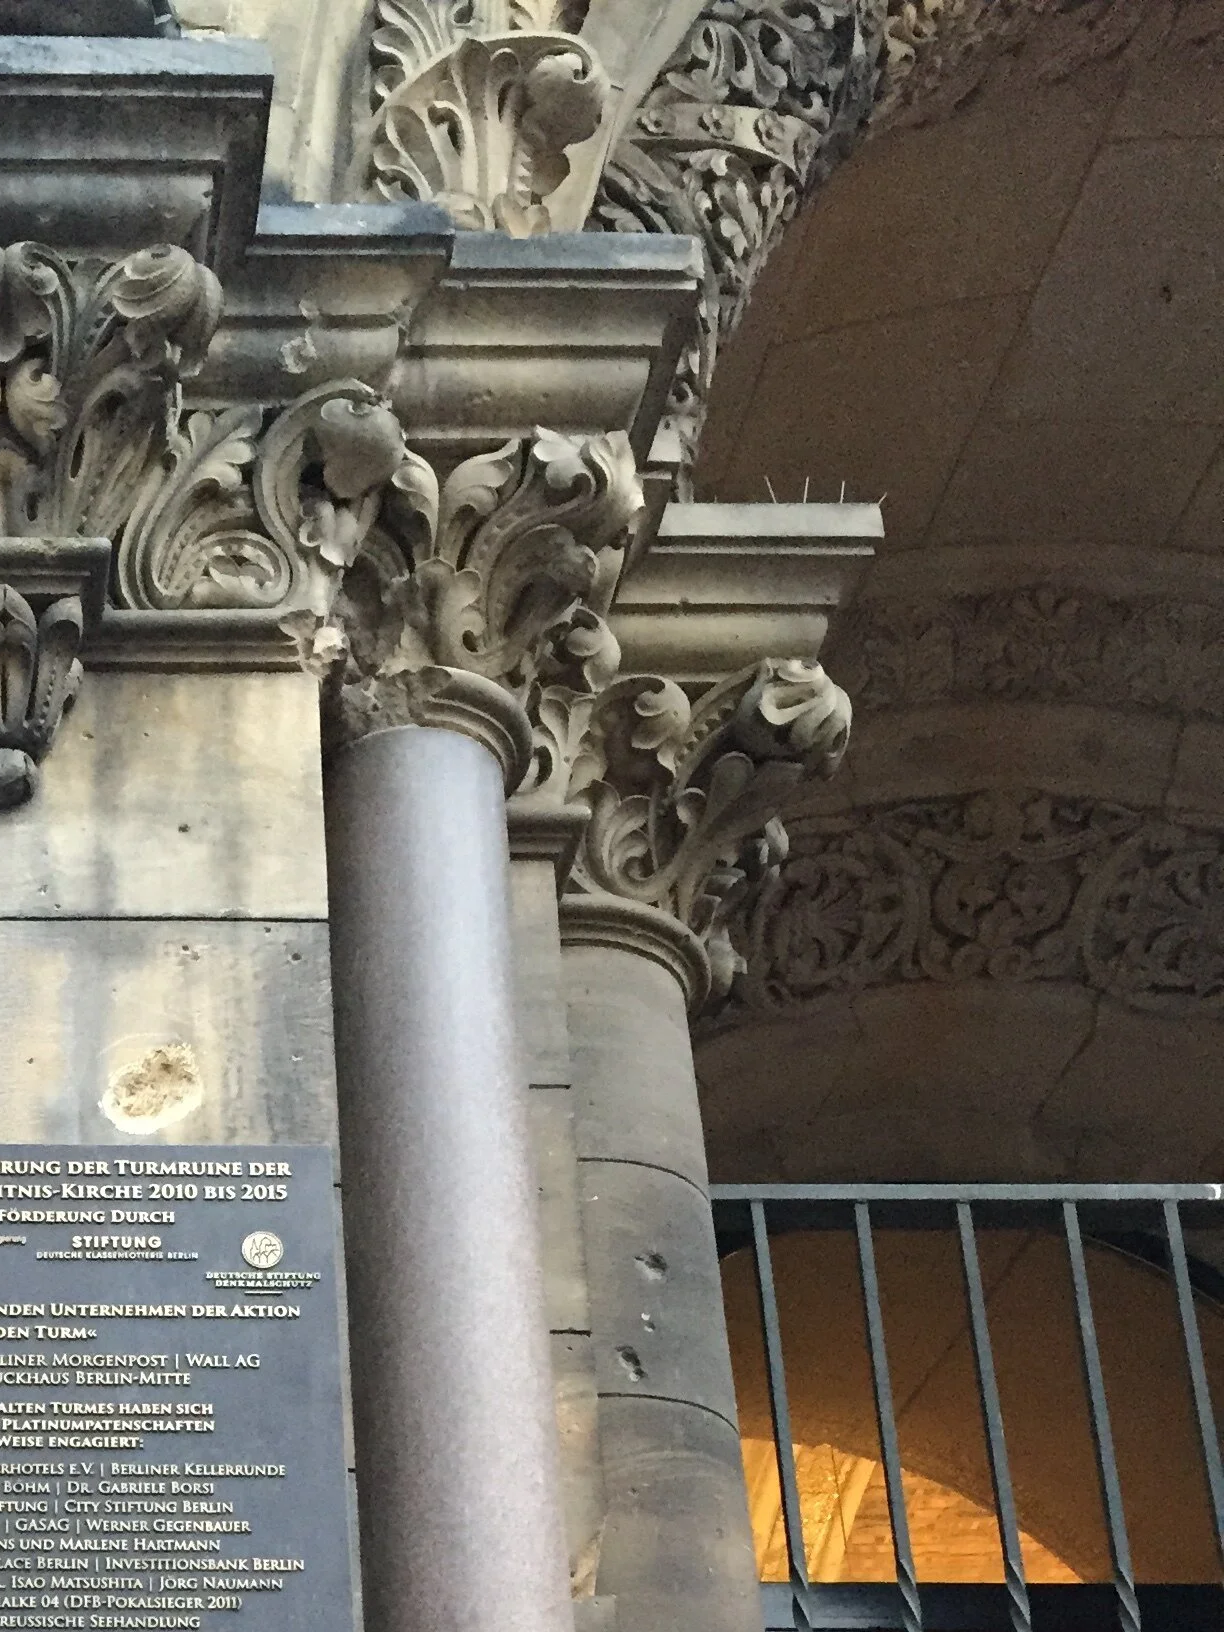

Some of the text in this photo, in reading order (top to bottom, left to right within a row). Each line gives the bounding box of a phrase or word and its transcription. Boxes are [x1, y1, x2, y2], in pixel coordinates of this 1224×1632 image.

[67, 1161, 111, 1175] DER
[113, 1159, 243, 1175] TURMRUINE
[248, 1162, 291, 1176] DER
[147, 1183, 199, 1199] 2010
[203, 1184, 237, 1199] BIS
[240, 1184, 288, 1200] 2015
[110, 1209, 176, 1223] DURCH
[71, 1235, 163, 1248] STIFTUNG
[35, 1250, 83, 1260] DEUTSCHE
[166, 1251, 199, 1261] BERLIN
[205, 1271, 322, 1281] DEUTSCHE STIFTUNG
[214, 1279, 313, 1288] DENKMALSCHUTZ
[50, 1302, 188, 1317] UNTERNEHMEN
[190, 1304, 229, 1317] DER
[230, 1304, 301, 1318] AKTION
[49, 1401, 115, 1414] TURMES
[118, 1402, 173, 1415] HABEN
[175, 1402, 214, 1415] SICH
[1, 1418, 215, 1431] PLATINUMPATENSCHAFTEN
